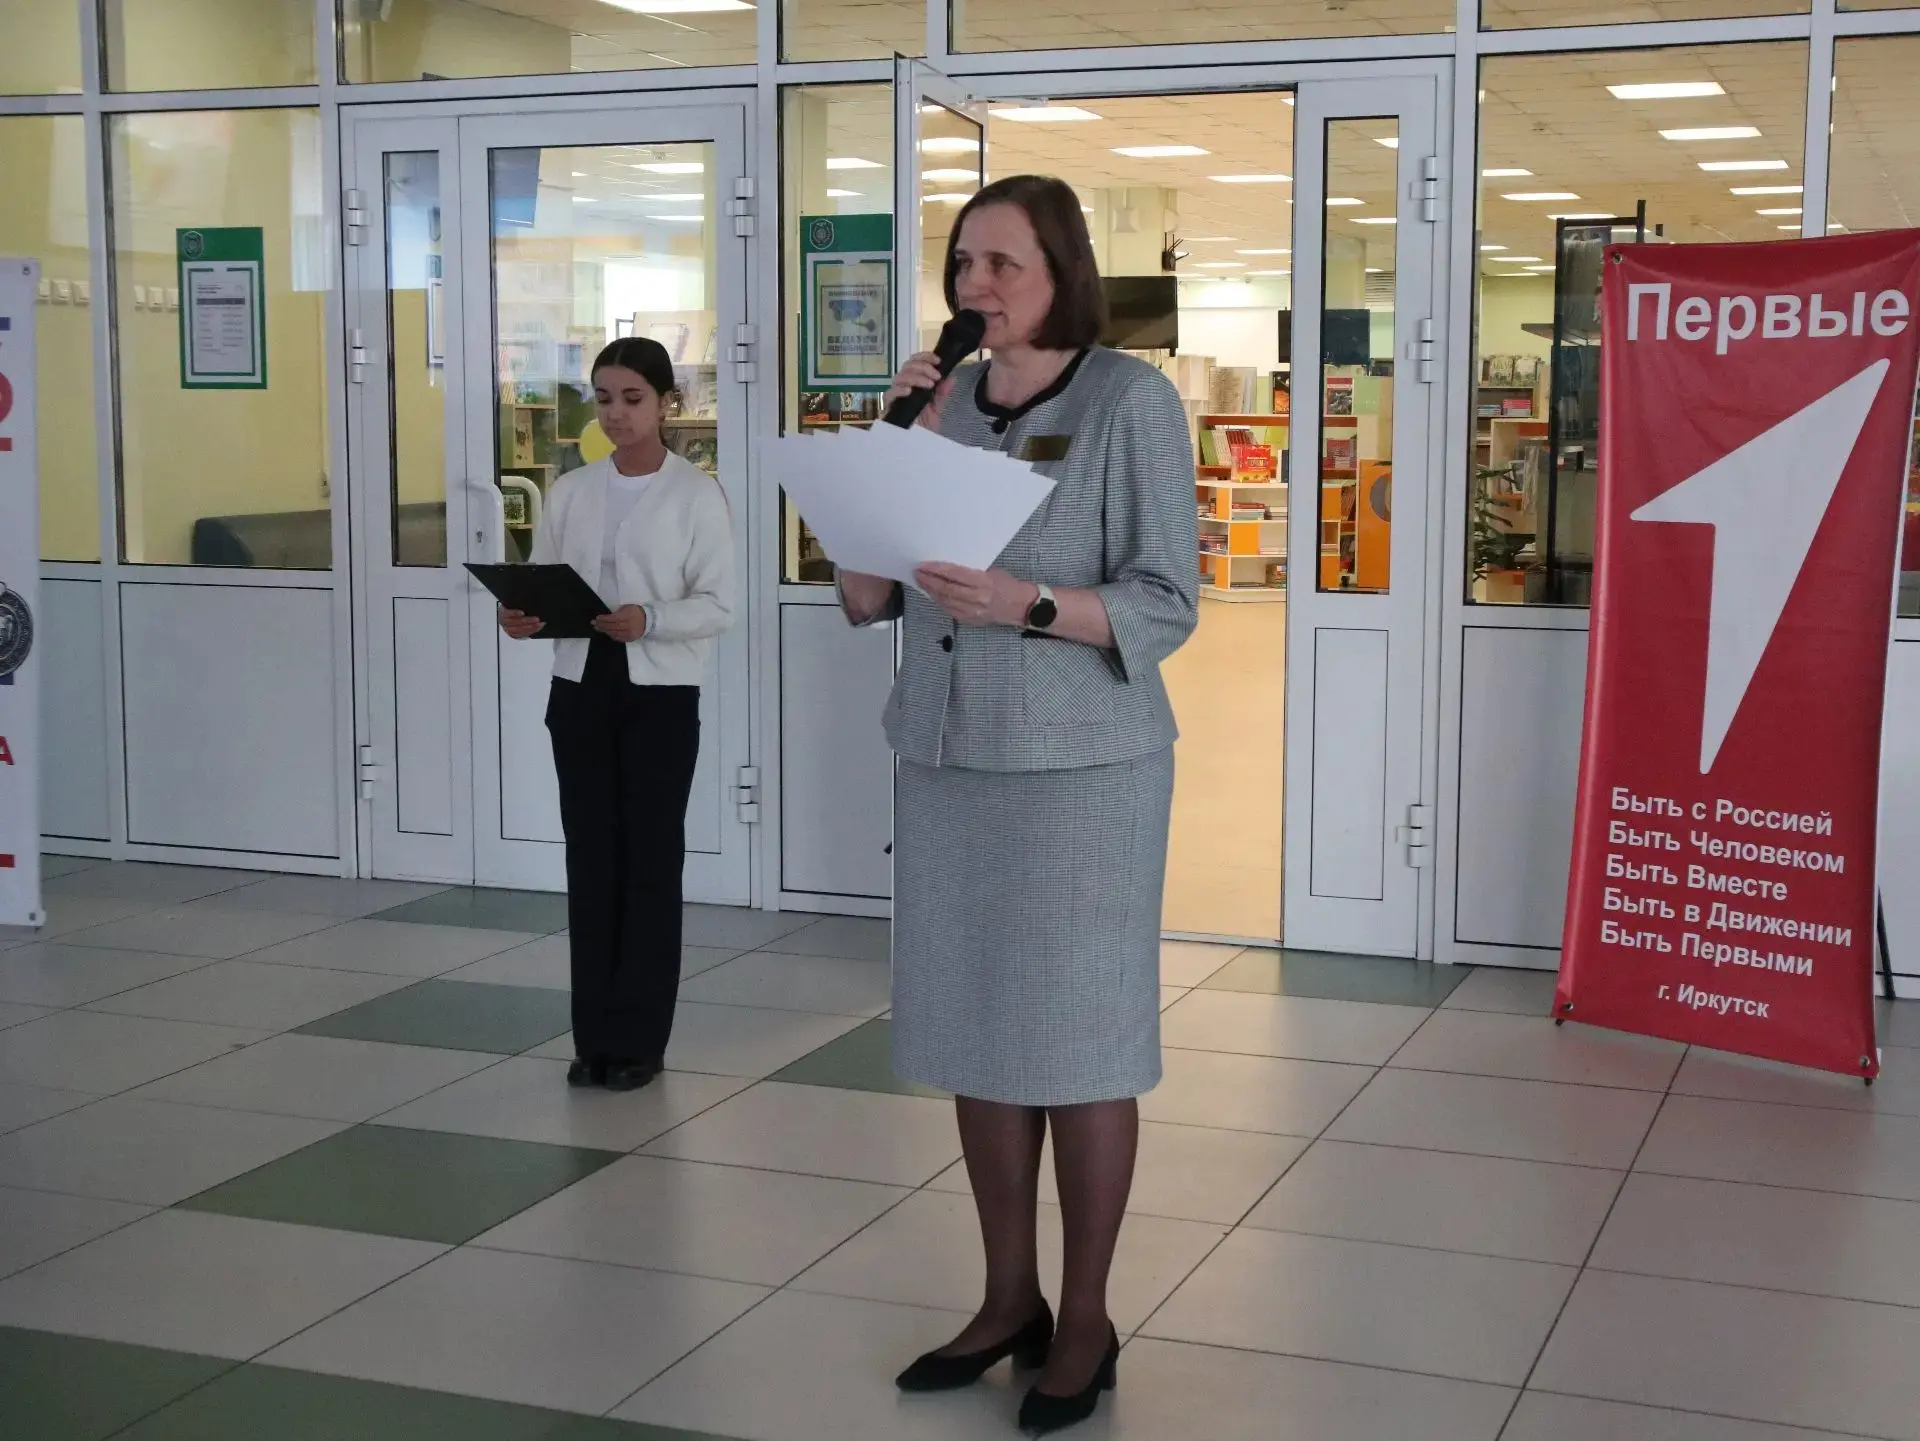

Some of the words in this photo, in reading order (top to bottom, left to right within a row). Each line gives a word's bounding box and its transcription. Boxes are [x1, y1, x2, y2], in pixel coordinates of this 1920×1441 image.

[1627, 282, 1910, 356] Первые
[1611, 787, 1684, 817] Быть
[1691, 802, 1707, 820] с
[1715, 798, 1833, 836] Россией
[1608, 820, 1682, 851] Быть
[1690, 831, 1845, 874] Человеком
[1606, 854, 1679, 885] Быть
[1687, 865, 1788, 901] Вместе
[1603, 887, 1676, 919] Быть
[1684, 904, 1701, 923] в
[1706, 902, 1852, 947] Движении
[1600, 920, 1672, 953] Быть
[1681, 932, 1813, 977] Первыми
[1657, 985, 1671, 1000] г.
[1677, 983, 1770, 1018] Иркутск
